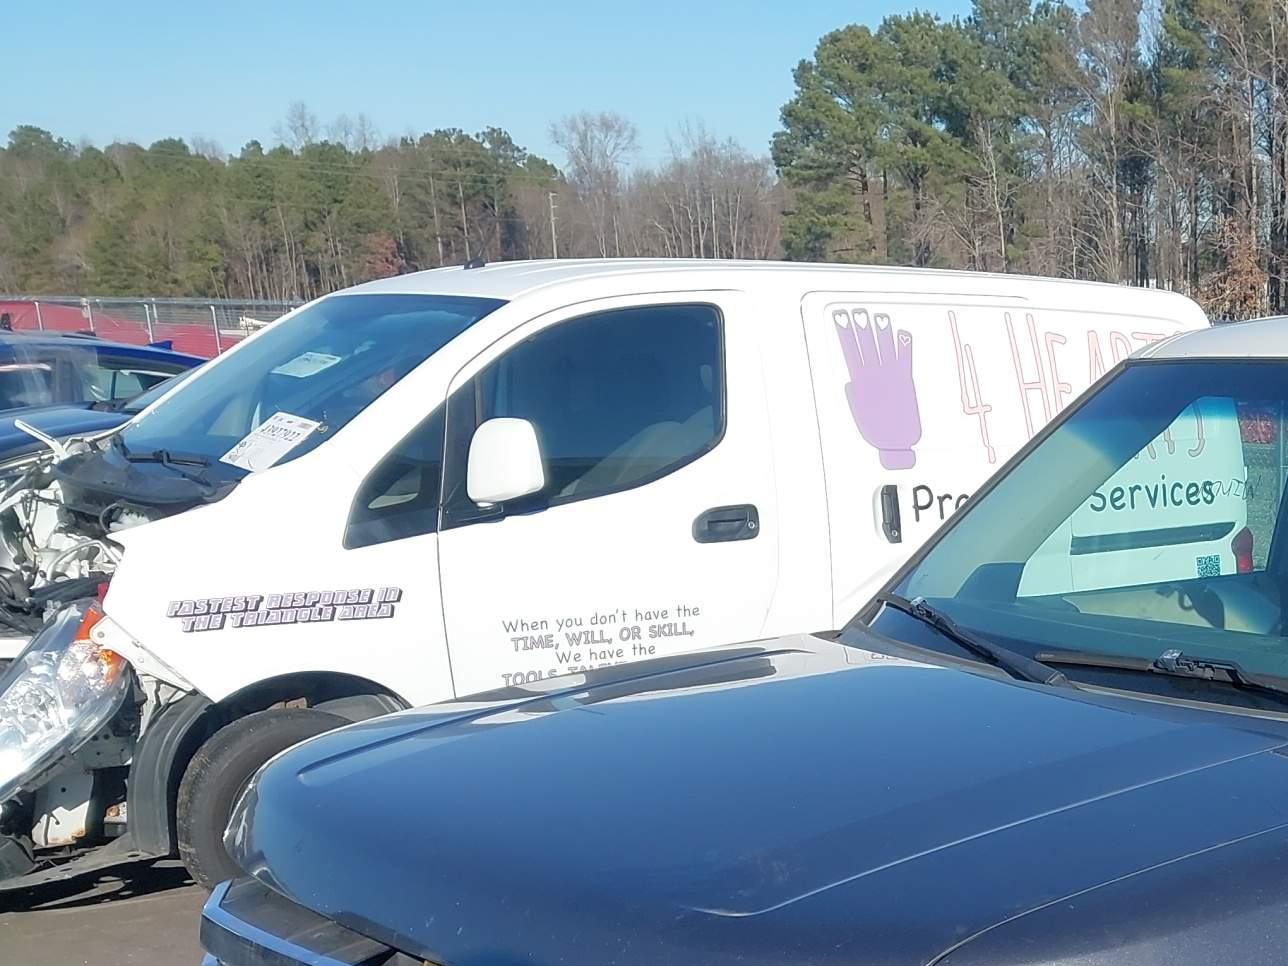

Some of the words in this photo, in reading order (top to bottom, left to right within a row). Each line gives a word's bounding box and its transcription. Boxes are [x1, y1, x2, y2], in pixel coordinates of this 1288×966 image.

[947, 310, 997, 464] 4
[1004, 312, 1206, 457] HEAT
[1088, 474, 1215, 512] Services
[166, 594, 264, 618] FASTEST
[266, 588, 374, 610] RESPONSE
[376, 587, 403, 603] IN
[182, 614, 226, 633] THE
[231, 606, 336, 629] TRIANGLE
[337, 603, 395, 620] AREA
[502, 618, 549, 633] When
[556, 617, 583, 632] you
[590, 608, 628, 626] don't
[635, 608, 669, 621] have
[677, 604, 700, 617] the
[510, 634, 560, 652] TIME,
[565, 630, 613, 646] WILL,
[619, 626, 642, 641] OR
[649, 622, 695, 638] SKILL,
[555, 650, 582, 664] We
[589, 647, 624, 661] have
[632, 643, 656, 656] the
